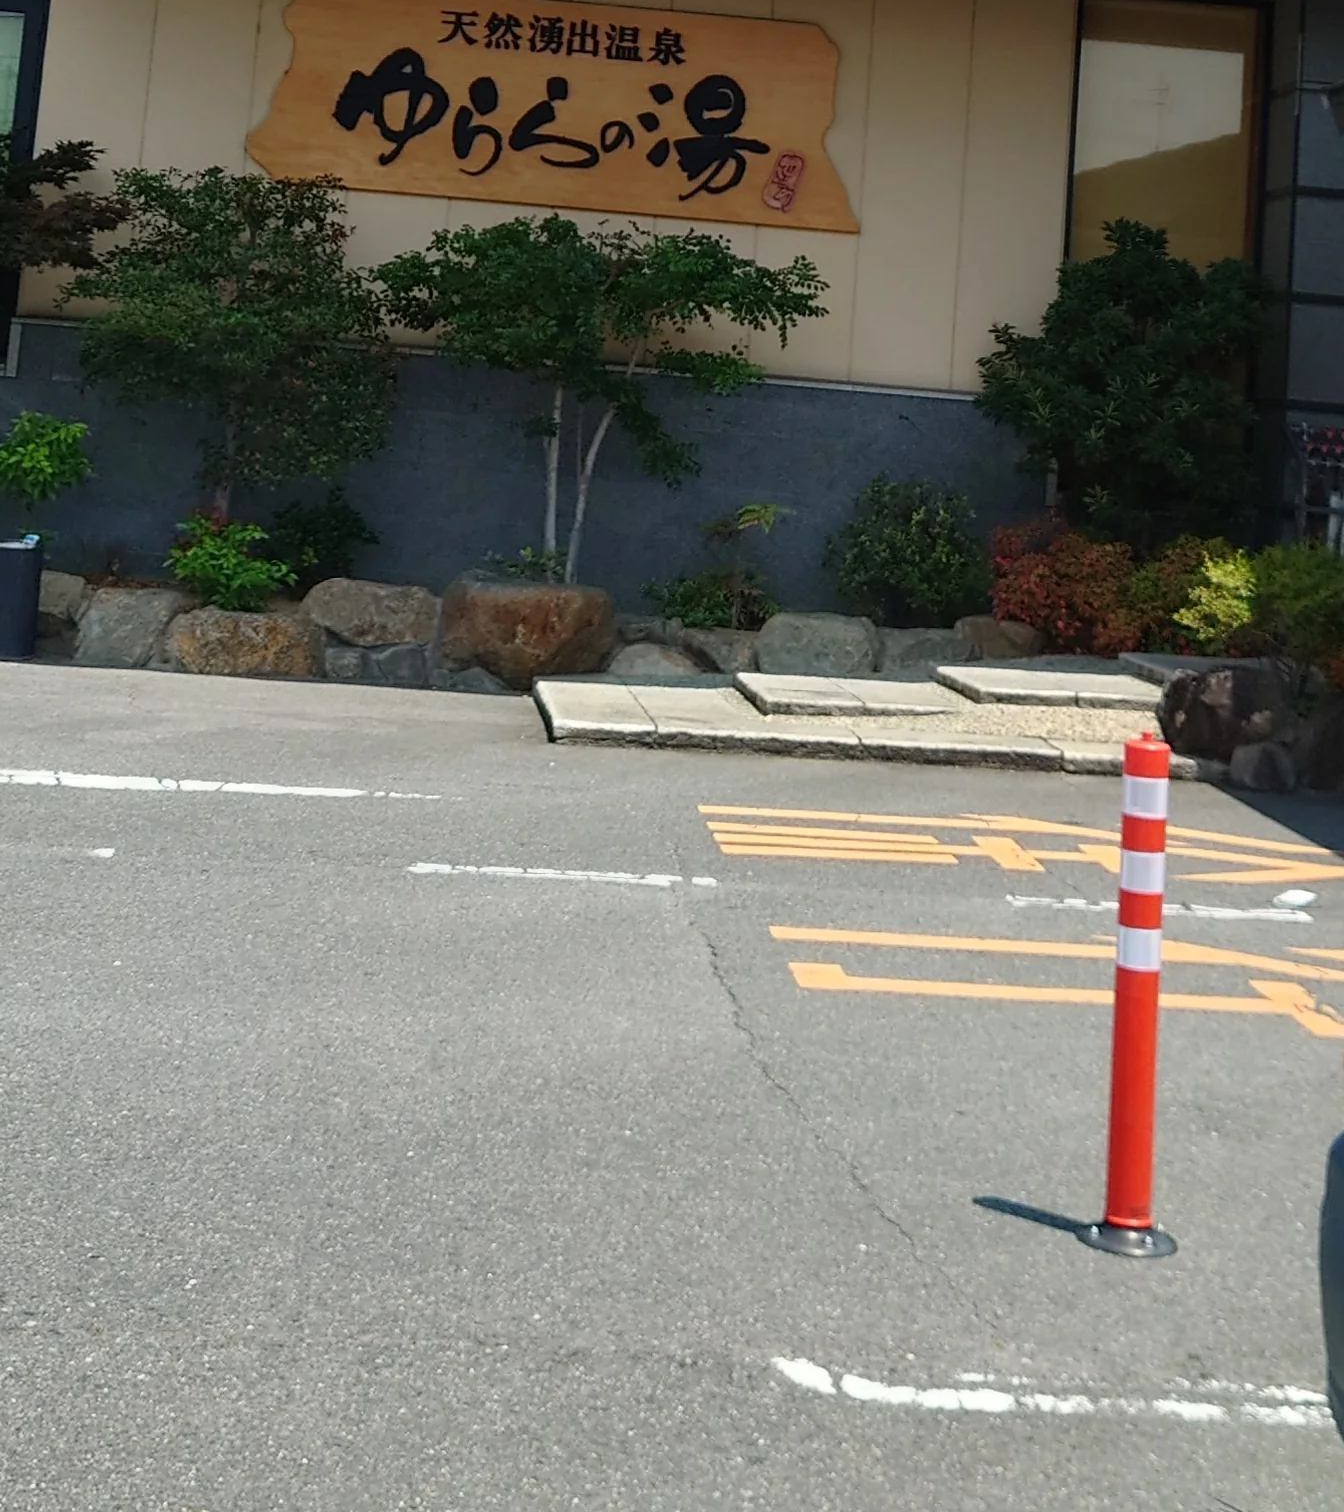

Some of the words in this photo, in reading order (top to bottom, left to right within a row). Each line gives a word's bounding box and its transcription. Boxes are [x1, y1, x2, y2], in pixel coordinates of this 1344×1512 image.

[437, 10, 688, 66] 天然湧出温泉
[332, 46, 770, 201] ゆららの湯
